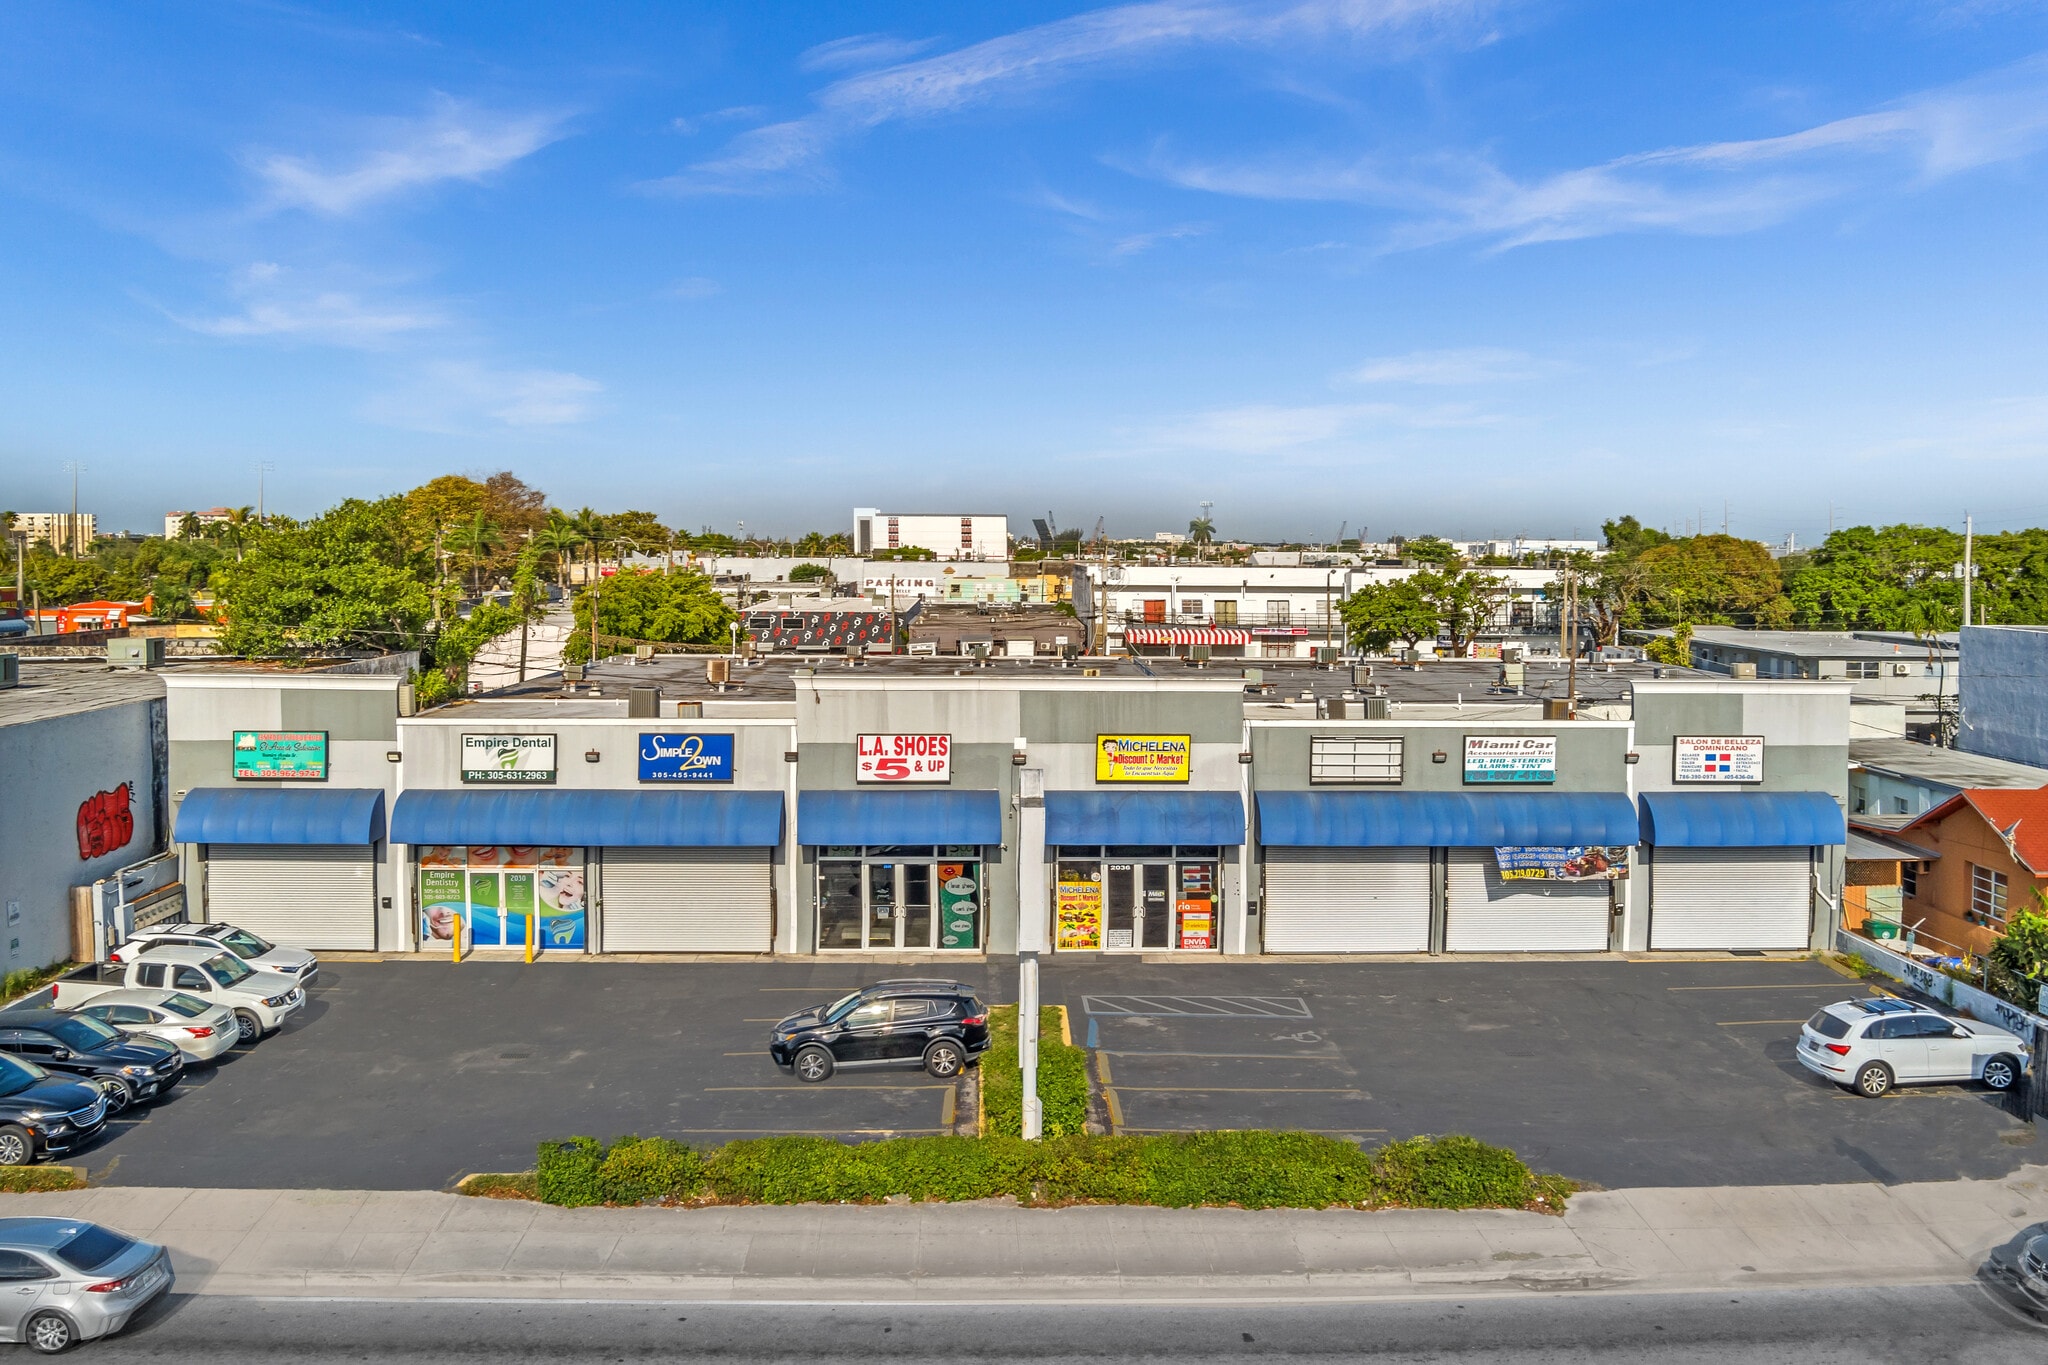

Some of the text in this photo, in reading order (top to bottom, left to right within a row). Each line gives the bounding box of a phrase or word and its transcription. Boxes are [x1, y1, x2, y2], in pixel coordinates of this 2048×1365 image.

[866, 579, 934, 587] PARKING
[466, 737, 551, 749] Empire Dental
[859, 735, 948, 756] L.A. SHOES
[1468, 740, 1553, 749] Miami Car
[680, 735, 707, 771] 2
[693, 756, 722, 766] OWN
[1118, 754, 1147, 764] Discount
[1156, 754, 1184, 764] Market
[914, 760, 923, 772] &
[928, 760, 945, 772] UP
[487, 771, 547, 780] 305-631-2963
[430, 871, 455, 879] Empire
[426, 879, 459, 887] Dentistry
[1178, 902, 1191, 910] ria
